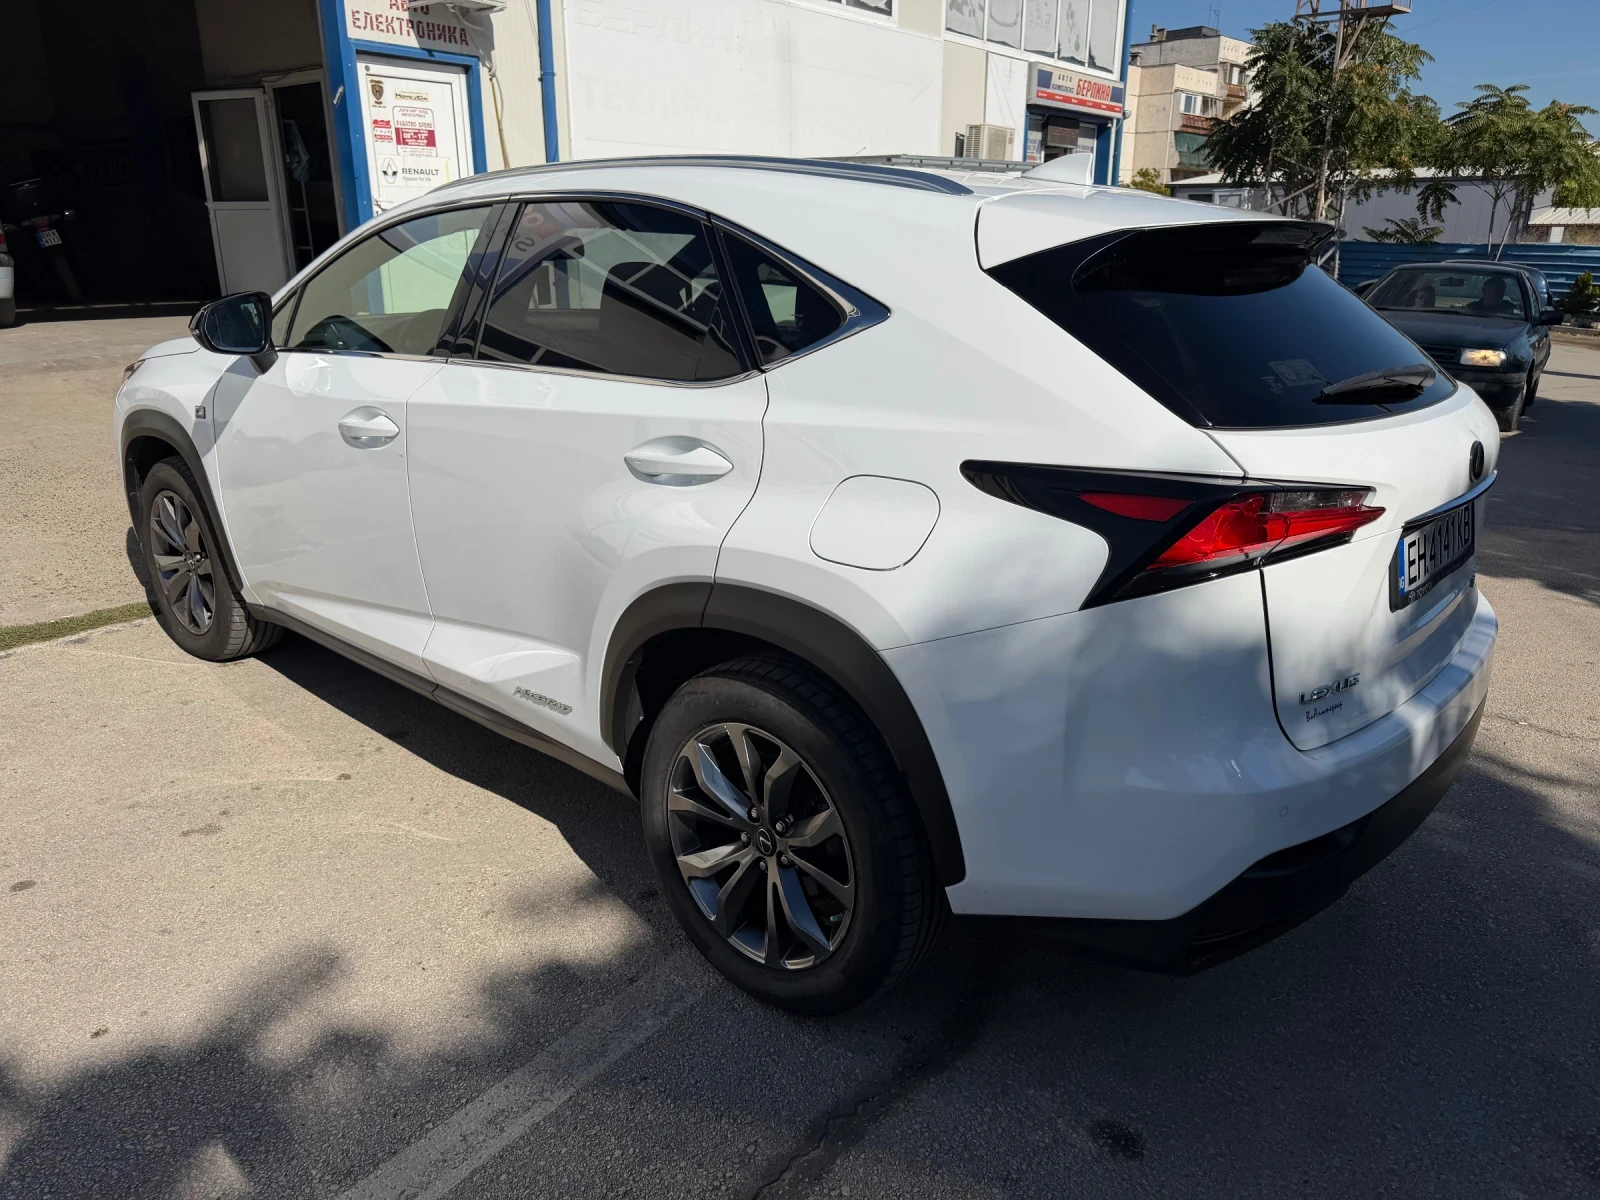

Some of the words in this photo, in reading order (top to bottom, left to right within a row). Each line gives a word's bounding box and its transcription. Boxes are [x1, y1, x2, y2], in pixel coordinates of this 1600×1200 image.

[351, 9, 469, 46] ЕЛЕКТРОНИКА
[1058, 73, 1073, 82] АВТО
[1076, 78, 1111, 102] БЕРЛИНА
[1299, 672, 1360, 705] LEXUS
